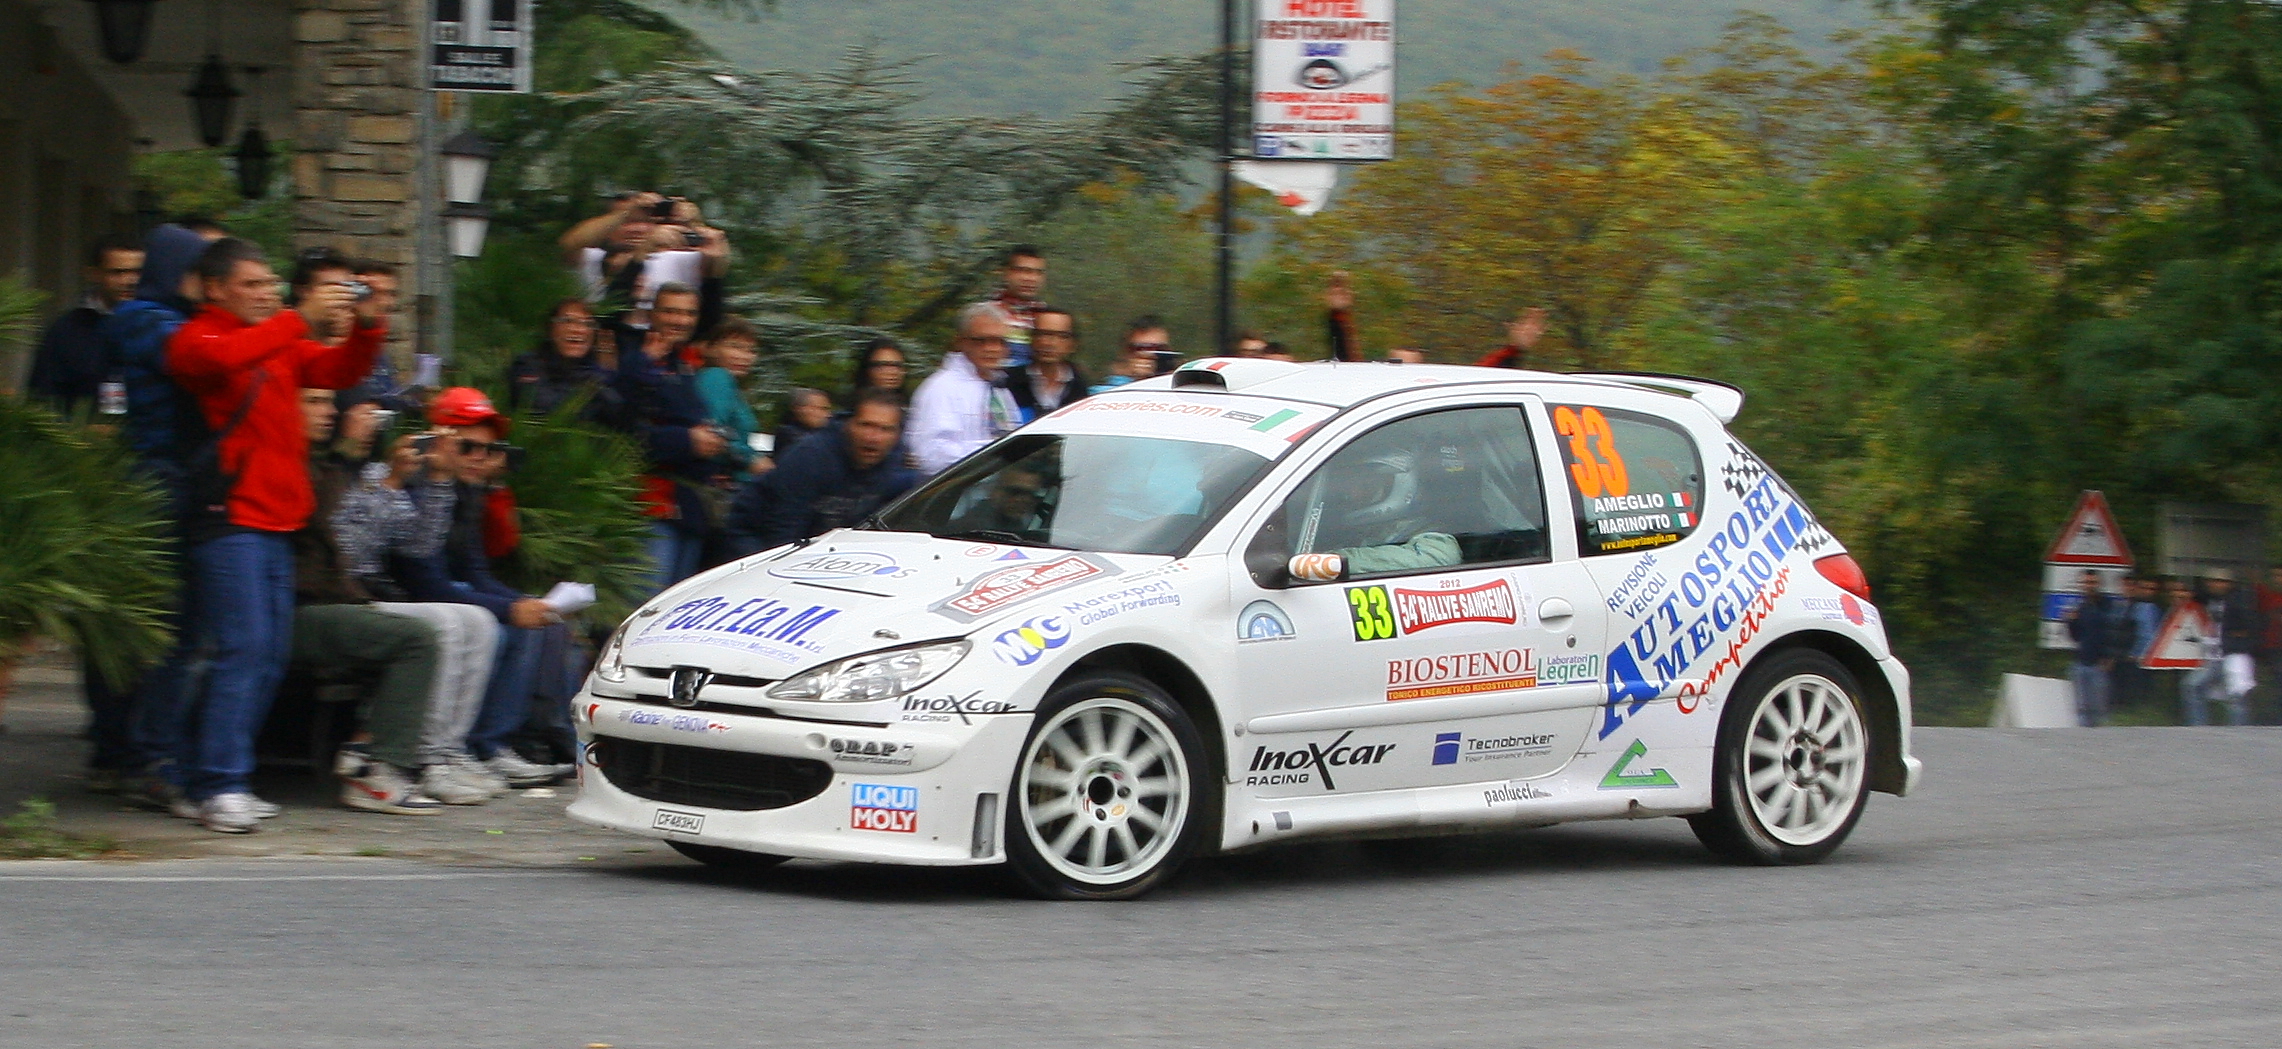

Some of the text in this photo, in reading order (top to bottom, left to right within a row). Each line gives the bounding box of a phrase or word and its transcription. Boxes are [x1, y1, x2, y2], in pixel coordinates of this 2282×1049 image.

[1554, 406, 1629, 499] 33
[1594, 493, 1665, 514] AMEGLIO
[1596, 514, 1671, 535] MARINOTTO
[1063, 579, 1174, 614] Marexport
[1439, 579, 1461, 588] 2012
[1607, 551, 1658, 614] REVISIONE
[1624, 573, 1668, 620] VEICOLI
[1080, 593, 1181, 626] Global Forwarding
[1349, 586, 1394, 641] 33
[1420, 593, 1461, 624] RALLYE
[1461, 583, 1513, 619] SANREMO
[1598, 474, 1781, 742] AUTOSPORT
[1676, 565, 1792, 714] Competition
[1387, 648, 1537, 685] BIOSTENOL
[1547, 655, 1588, 665] Laboratori
[1467, 733, 1554, 751] Tecnobroker
[1247, 774, 1309, 786] RACING
[1484, 783, 1532, 807] paolucci
[855, 786, 916, 808] LIQUI
[852, 809, 916, 832] MOLY
